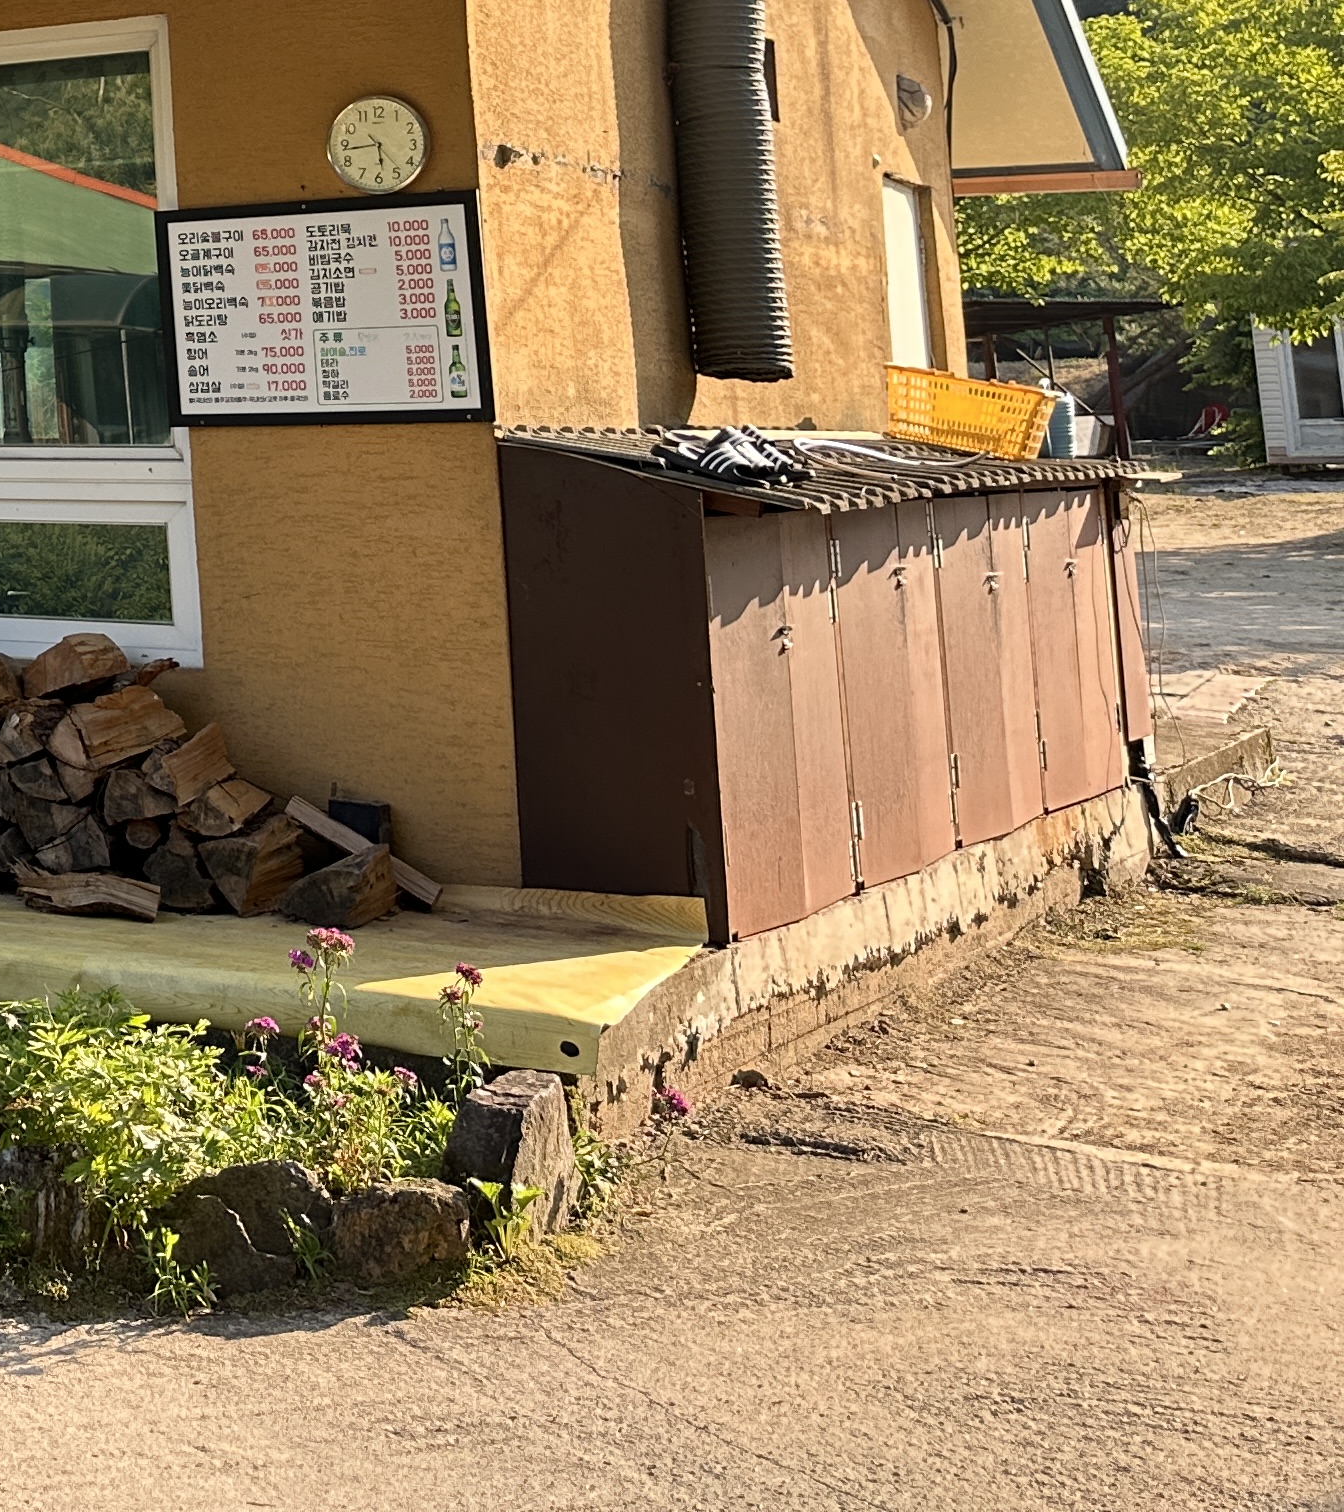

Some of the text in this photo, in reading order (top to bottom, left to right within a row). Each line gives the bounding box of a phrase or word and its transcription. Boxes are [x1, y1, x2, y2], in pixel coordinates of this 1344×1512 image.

[358, 110, 368, 122] 11
[372, 106, 385, 119] 12
[394, 110, 399, 122] 1
[345, 123, 356, 135] 10
[406, 122, 415, 134] 2
[341, 139, 349, 151] 9
[409, 139, 417, 151] 3
[344, 155, 352, 167] 8
[406, 156, 414, 167] 4
[358, 167, 366, 179] 7
[375, 172, 384, 184] 6
[392, 167, 401, 179] 5
[305, 223, 352, 238] 도토리묵
[306, 238, 342, 252] 감자전
[308, 252, 354, 266] 비빔국수
[310, 266, 355, 280] 김치소면
[311, 281, 345, 294] 공기밥
[311, 296, 346, 309] 볶음밥
[184, 331, 218, 344] 흑염소
[189, 381, 222, 394] 삼겹살
